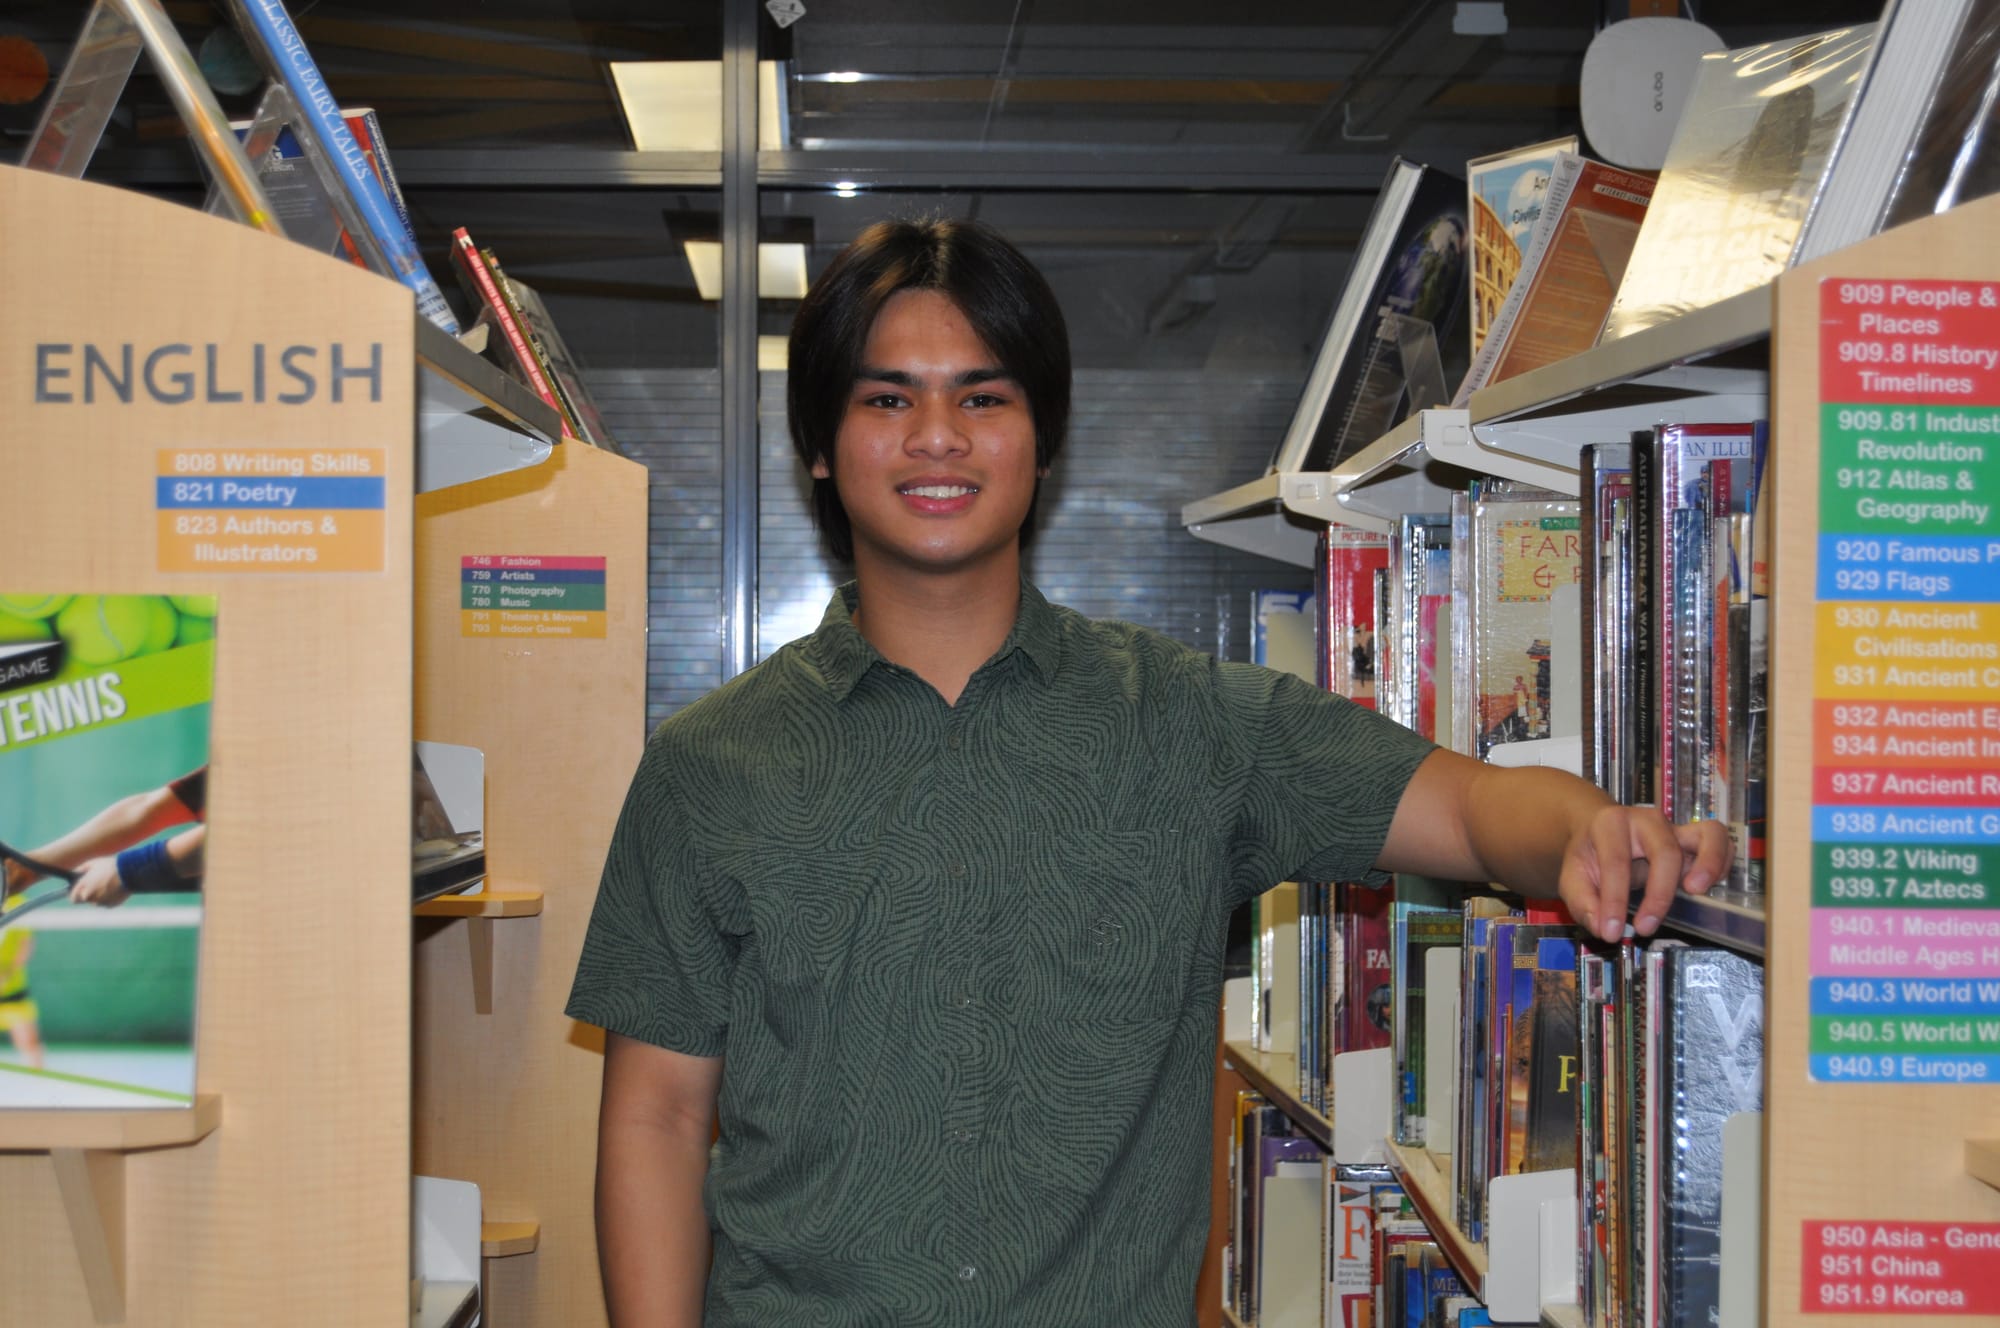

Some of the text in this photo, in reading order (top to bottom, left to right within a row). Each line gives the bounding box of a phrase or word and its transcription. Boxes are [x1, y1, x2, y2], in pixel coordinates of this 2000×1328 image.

[259, 0, 372, 182] LASSIC FAIRY TALES
[1840, 284, 1997, 310] 909 People &
[1859, 313, 1940, 334] Places
[1839, 342, 1998, 370] 909.8 History
[35, 342, 383, 405] ENGLISH
[1858, 371, 1973, 394] Timelines
[1838, 410, 1917, 431] 909.81
[1857, 440, 1984, 462] Revolution
[175, 454, 371, 477] 808 Writing Skills
[1837, 468, 1974, 491] 912 Atlas &
[174, 482, 297, 506] 821 Poetry
[1639, 452, 1649, 576] AUSTRALIANS
[1856, 498, 1989, 525] Geography
[175, 516, 337, 535] 823 Authors &
[195, 543, 318, 562] Illustrators
[501, 557, 541, 566] Fashion
[1836, 541, 1880, 561] 920
[1887, 542, 1980, 563] Famous
[472, 571, 535, 580] 759 Artists
[1835, 570, 1951, 597] 929 Flags
[472, 585, 566, 597] 770 Photography
[1639, 582, 1649, 605] AT
[501, 598, 530, 607] Music
[501, 612, 539, 622] Theatre
[552, 613, 588, 622] Movies
[1835, 608, 1978, 629] 930 Ancient
[501, 624, 533, 633] Indoor
[536, 624, 572, 634] Games
[1639, 611, 1649, 650] WAR
[1854, 636, 1998, 658] Civilisations
[1834, 666, 1876, 686] 931
[1884, 666, 1976, 687] Ancient
[1833, 706, 1877, 726] 932
[1883, 706, 1976, 728] Ancient
[1832, 735, 1876, 756] 934
[1883, 736, 1975, 757] Ancient
[1832, 773, 1876, 794] 937
[1882, 773, 1975, 794] Ancient
[1832, 812, 1875, 833] 938
[1882, 813, 1974, 834] Ancient
[1830, 849, 1978, 875] 939.2 Viking
[1830, 877, 1985, 899] 939.7 Aztecs
[1830, 916, 2000, 937] 940.1 Medieva
[1829, 944, 1908, 965] Middle
[1915, 946, 1975, 970] Ages
[1829, 982, 1895, 1002] 940.3
[1902, 982, 1970, 1002] World
[1828, 1022, 1895, 1042] 940.5
[1901, 1022, 1970, 1042] World
[1828, 1056, 1987, 1082] 940.9 Europe
[1822, 1226, 1866, 1247] 950
[1872, 1226, 1924, 1247] Asia
[1945, 1227, 2000, 1248] Gene
[1821, 1255, 1941, 1277] 951 China
[1820, 1284, 1964, 1305] 951.9 Korea
